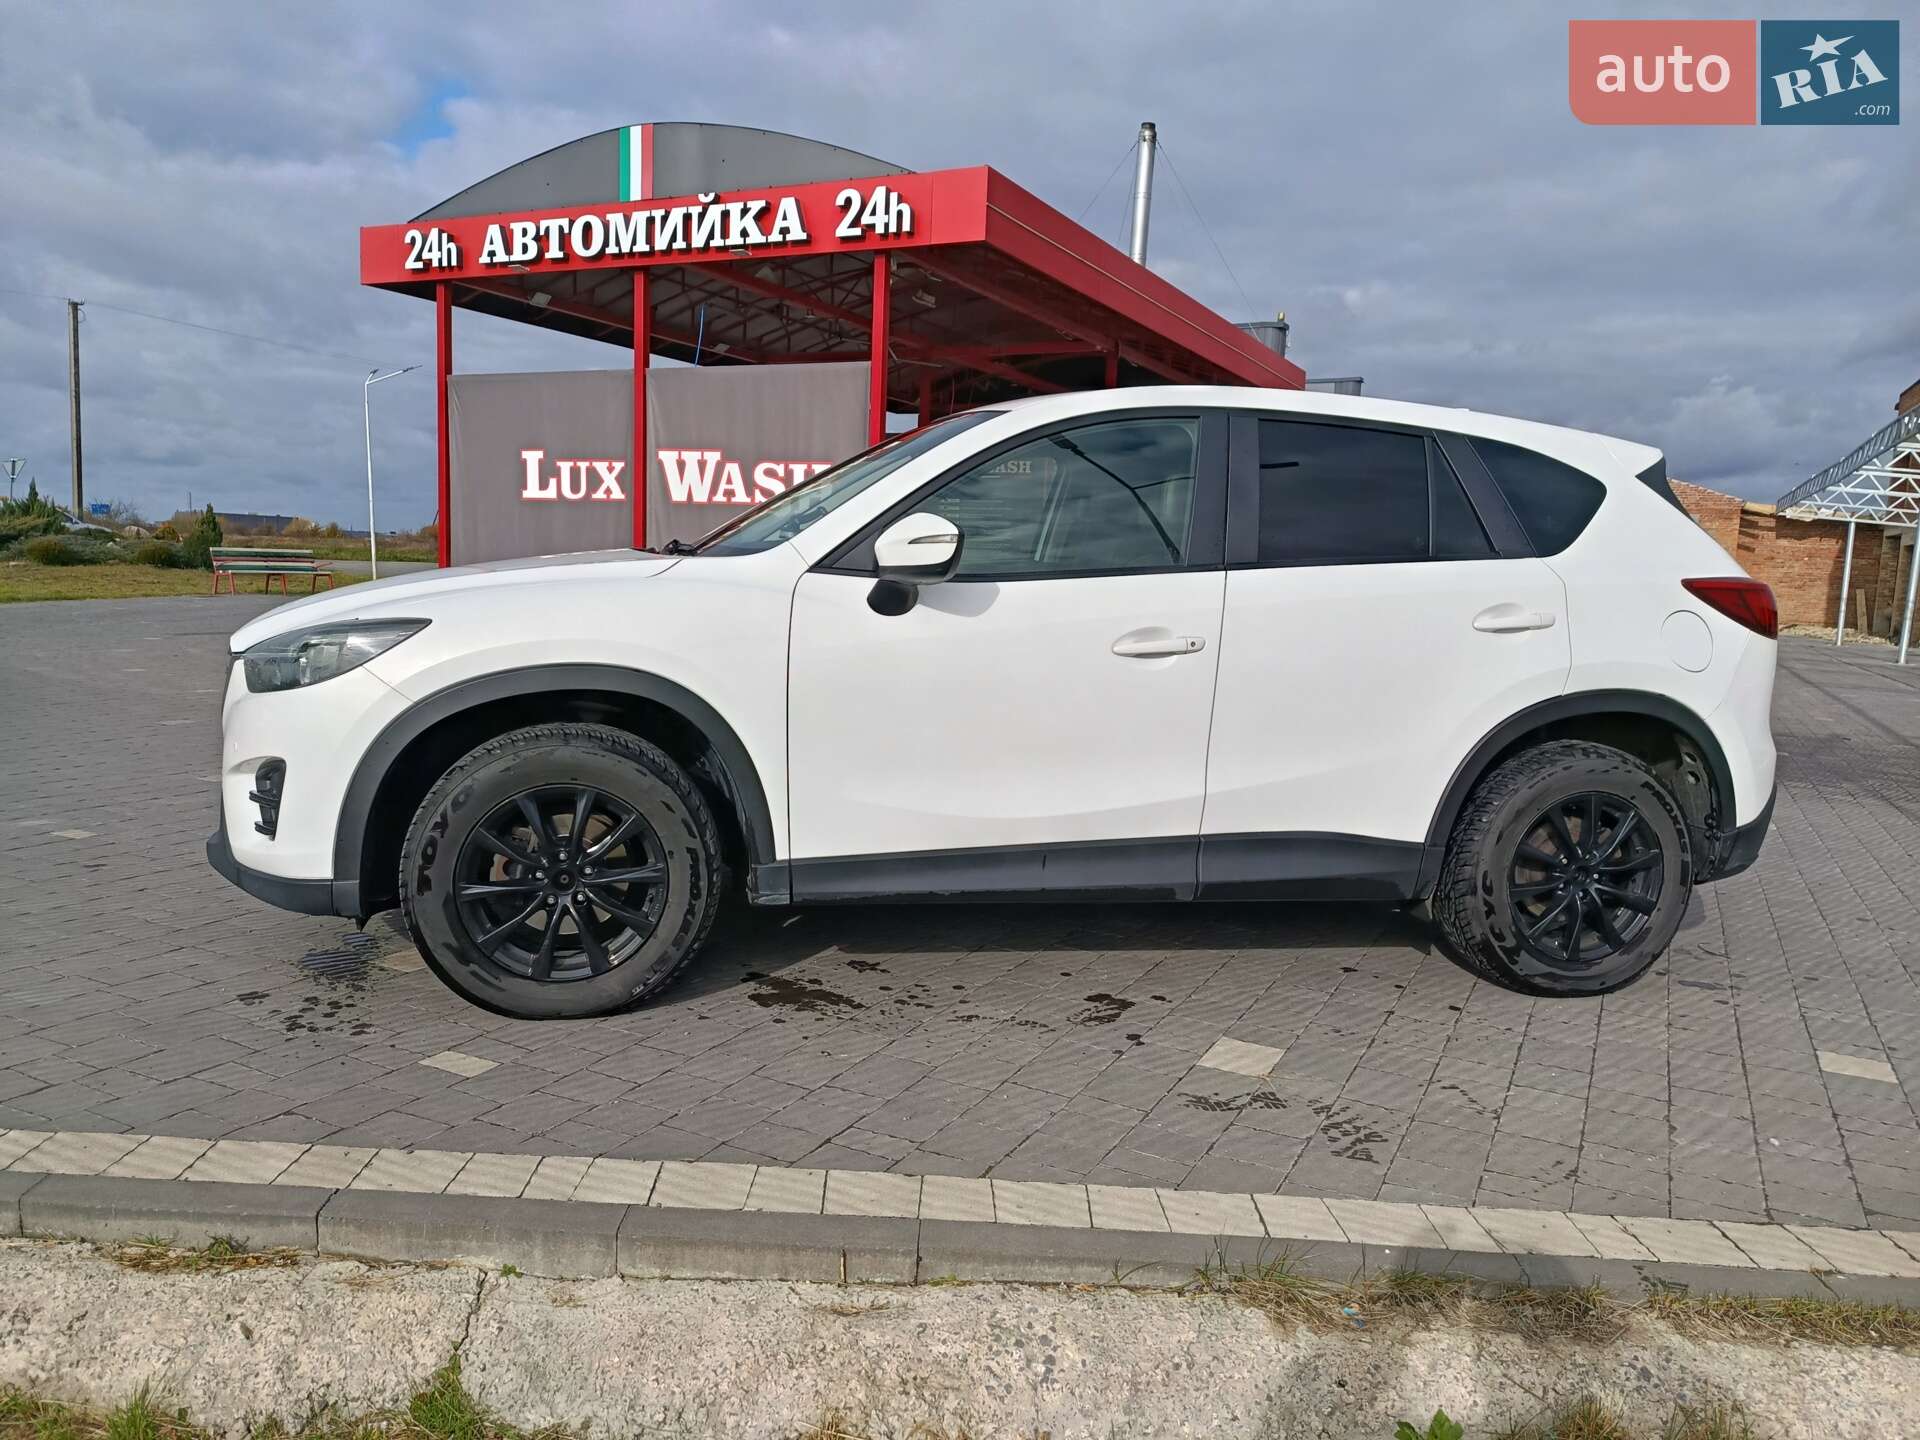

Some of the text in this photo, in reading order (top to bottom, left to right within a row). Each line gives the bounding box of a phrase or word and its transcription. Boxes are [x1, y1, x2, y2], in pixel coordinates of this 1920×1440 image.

[404, 185, 912, 272] 24h АВТОМИЙКА 24h
